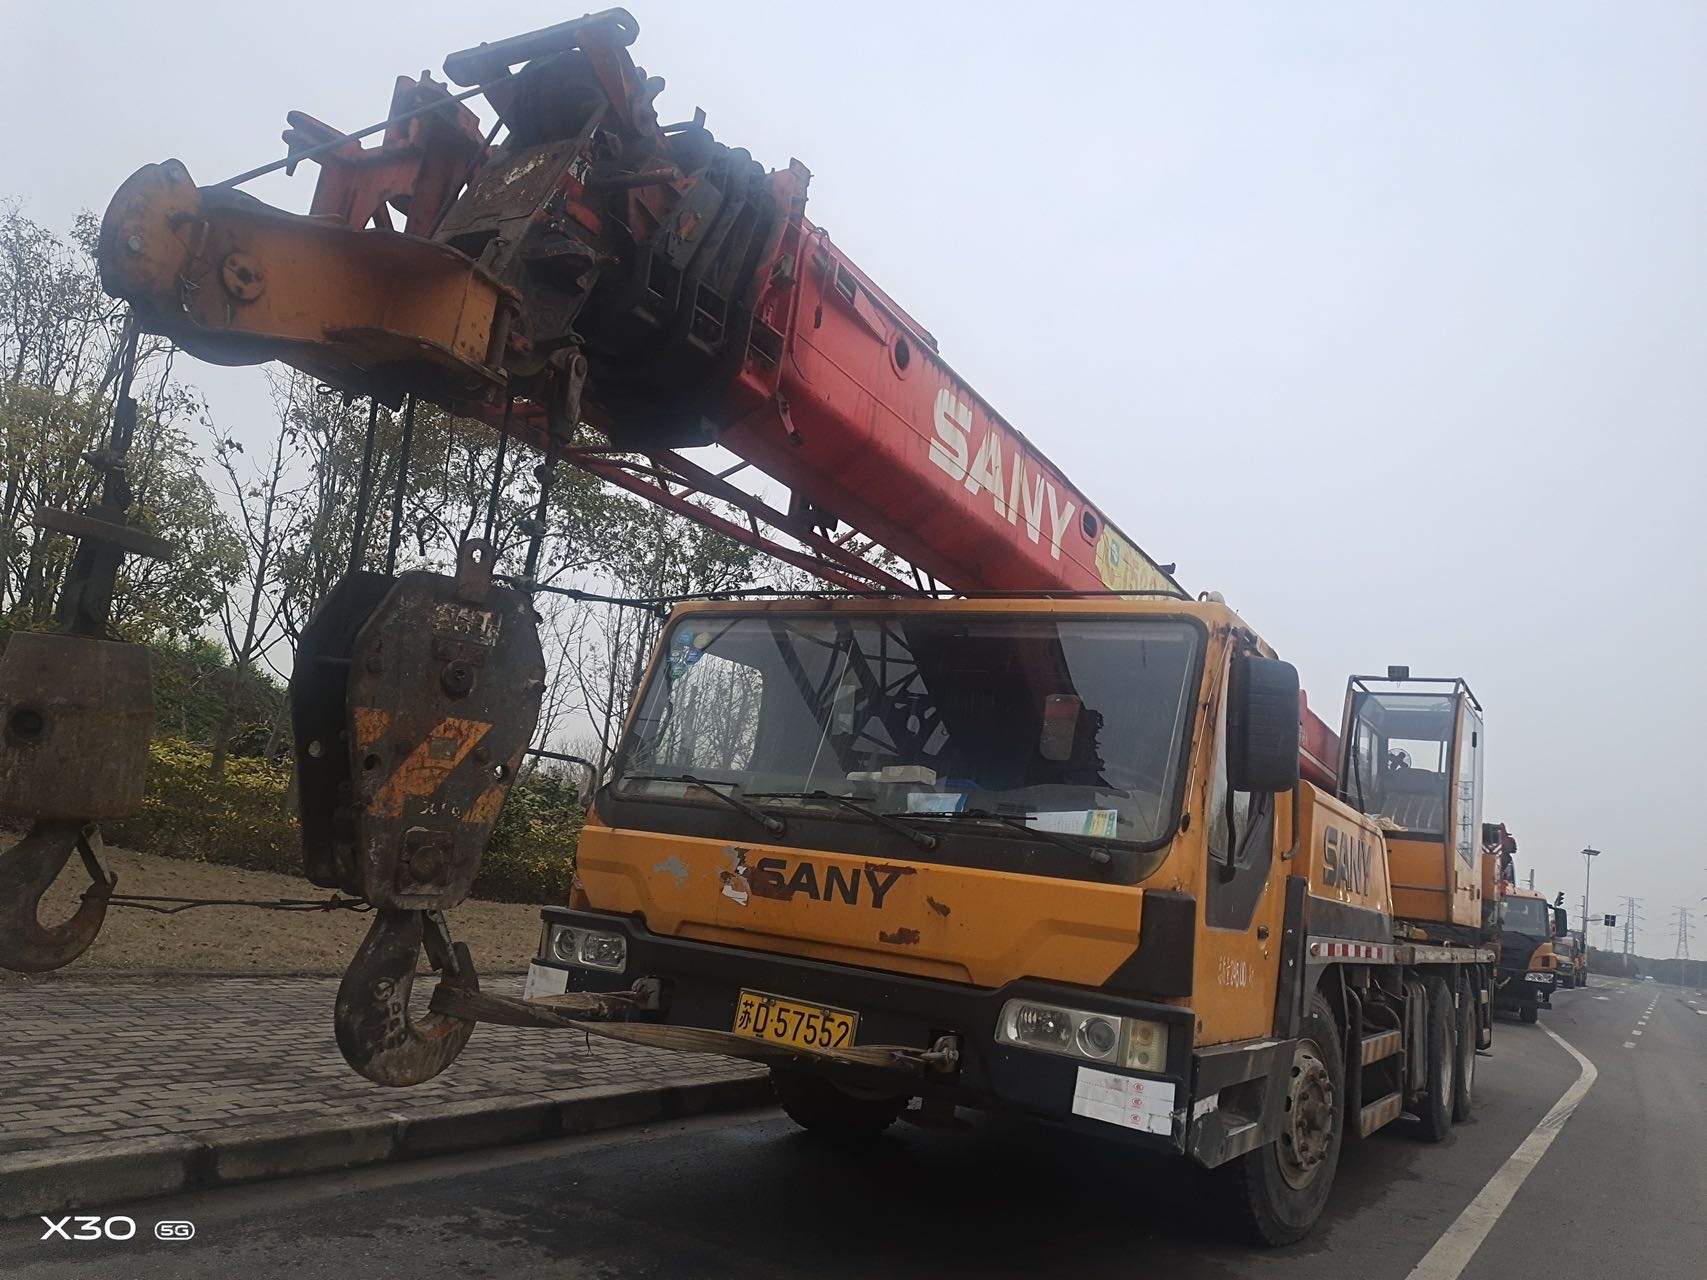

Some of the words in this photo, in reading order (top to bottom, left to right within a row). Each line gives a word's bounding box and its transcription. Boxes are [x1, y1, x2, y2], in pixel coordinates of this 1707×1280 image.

[929, 388, 1076, 560] SANY
[751, 857, 902, 909] SANY
[1323, 825, 1372, 897] SANY
